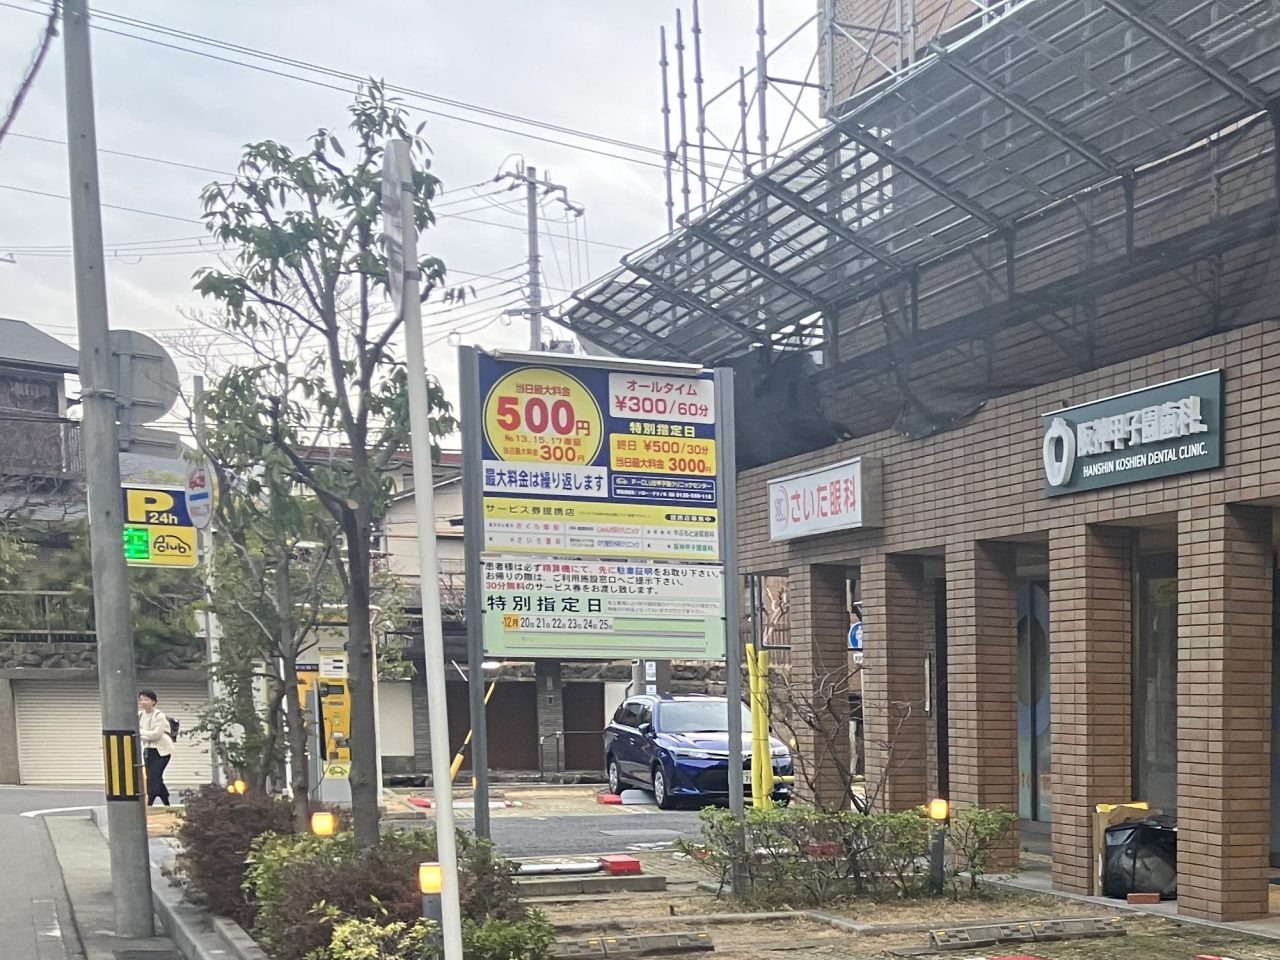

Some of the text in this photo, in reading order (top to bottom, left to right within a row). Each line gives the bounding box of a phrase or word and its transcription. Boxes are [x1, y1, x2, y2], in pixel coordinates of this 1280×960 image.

[515, 383, 570, 397] 当日最大料金
[626, 379, 698, 396] オールタイム
[615, 395, 709, 417] ¥300/60分
[496, 396, 590, 436] 500円
[629, 421, 696, 438] 特別指定日
[540, 444, 585, 462] 300円
[617, 440, 637, 451] 終日
[615, 457, 712, 473] 当日最大料金 3000円
[1083, 460, 1115, 477] HANSHIN
[1115, 455, 1147, 471] KOSHIEN
[1148, 449, 1178, 465] DENTAL
[485, 467, 604, 491] 最大料金は繰り返します
[127, 489, 174, 523] P
[149, 512, 178, 525] 24h
[487, 595, 602, 613] 特別指定日
